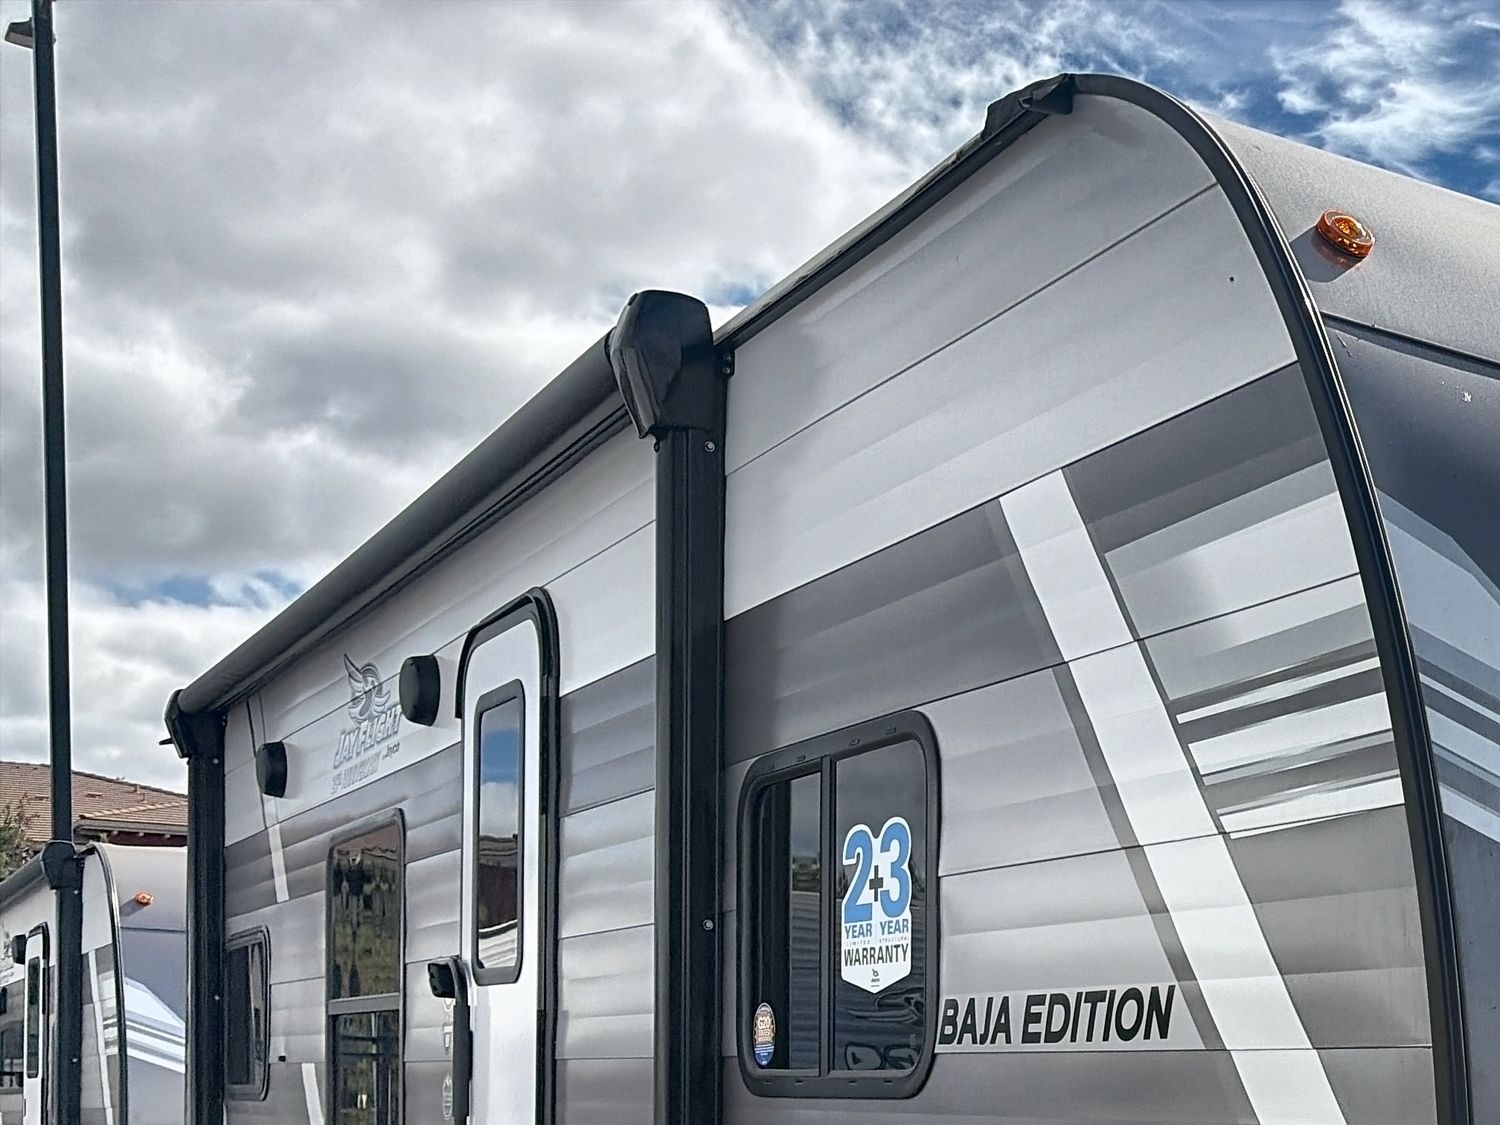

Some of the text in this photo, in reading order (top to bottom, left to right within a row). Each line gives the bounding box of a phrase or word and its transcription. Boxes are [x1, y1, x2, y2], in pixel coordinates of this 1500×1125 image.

[844, 919, 909, 940] YEAR YEAR
[844, 943, 909, 967] WARRANTY
[937, 984, 1176, 1045] BAJA EDITION
